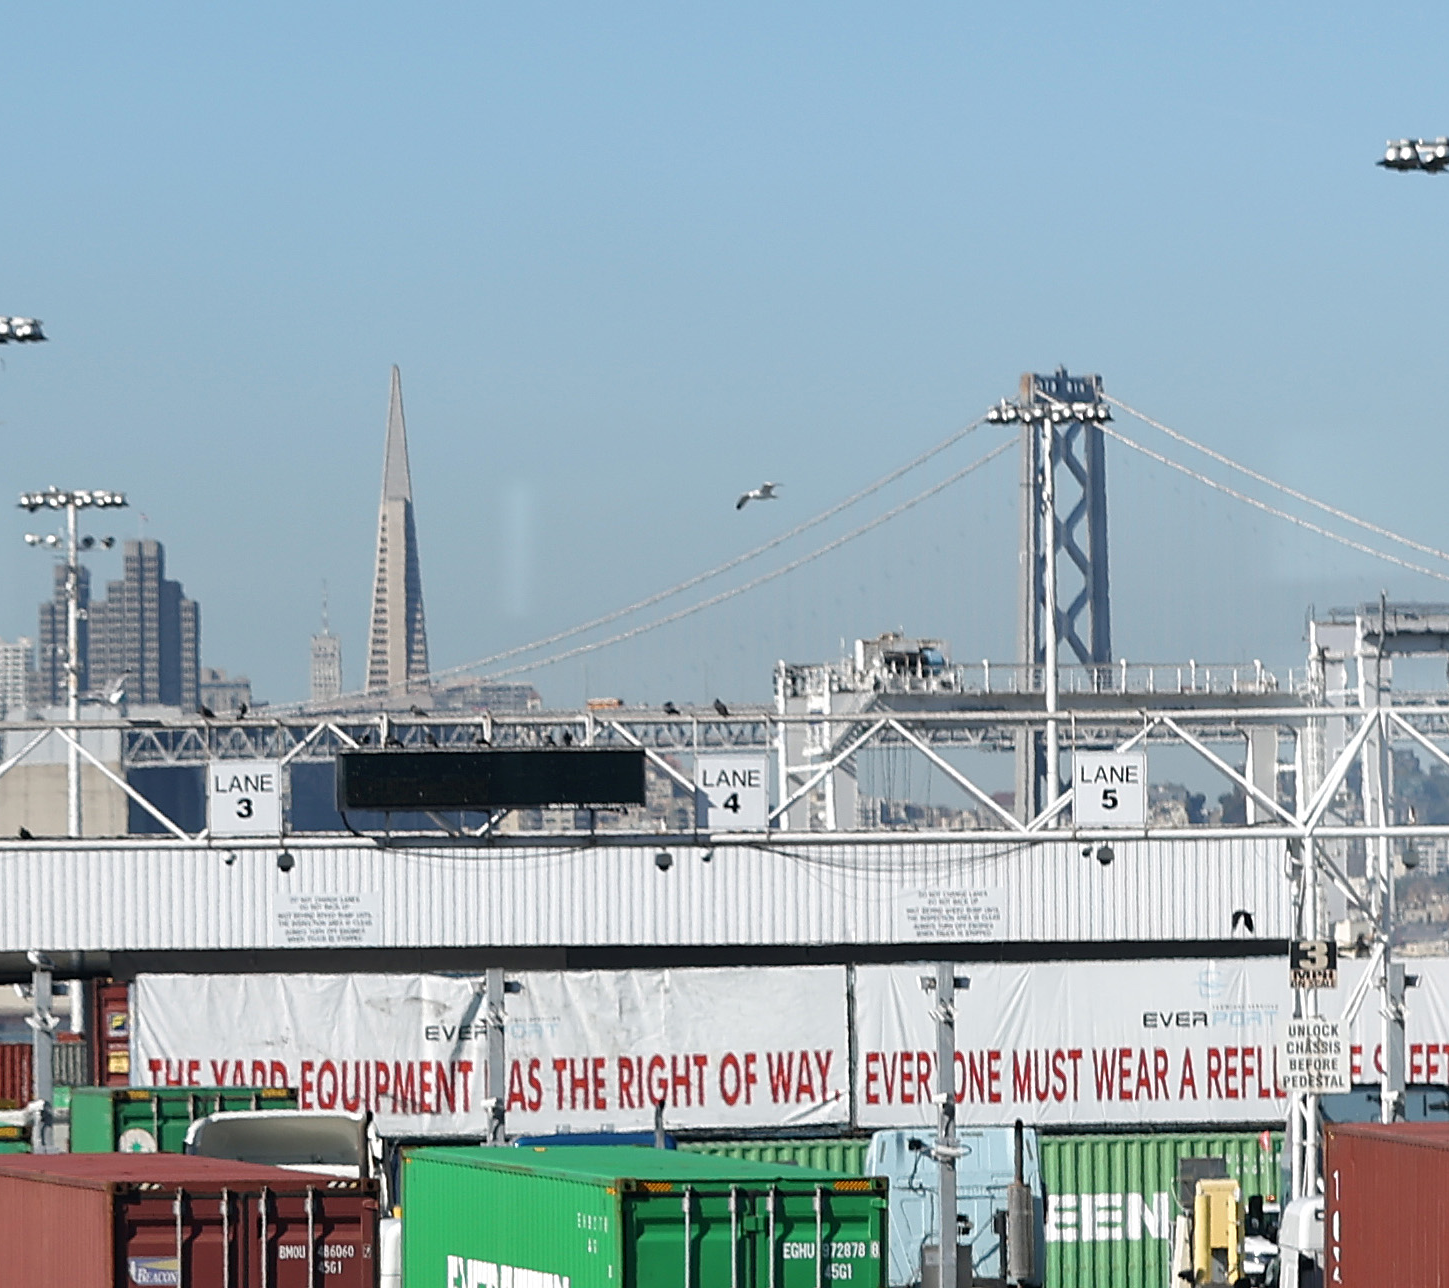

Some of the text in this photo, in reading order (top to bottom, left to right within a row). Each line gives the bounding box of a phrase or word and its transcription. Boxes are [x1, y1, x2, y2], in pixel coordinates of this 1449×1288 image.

[214, 773, 274, 792] LANE
[703, 769, 760, 787] LANE
[1081, 765, 1138, 784] LANE
[236, 798, 253, 818] 3
[723, 792, 741, 813] 4
[1102, 789, 1118, 810] 5
[1299, 940, 1328, 969] 3
[1288, 1024, 1339, 1037] UNLOCK
[1286, 1040, 1342, 1055] CHASSIS
[1288, 1057, 1339, 1071] BEFORE
[301, 1058, 474, 1113] EQUIPMENT
[553, 1056, 607, 1110] THE
[618, 1054, 708, 1109] RIGHT
[719, 1052, 759, 1107] OF
[766, 1049, 841, 1105] WAY.
[1012, 1049, 1083, 1102] MUST
[1093, 1047, 1170, 1101] WEAR
[1179, 1046, 1199, 1099] A
[1283, 1075, 1345, 1089] PEDESTAL
[278, 1244, 306, 1259] BMOU
[783, 1242, 815, 1259] EGHU
